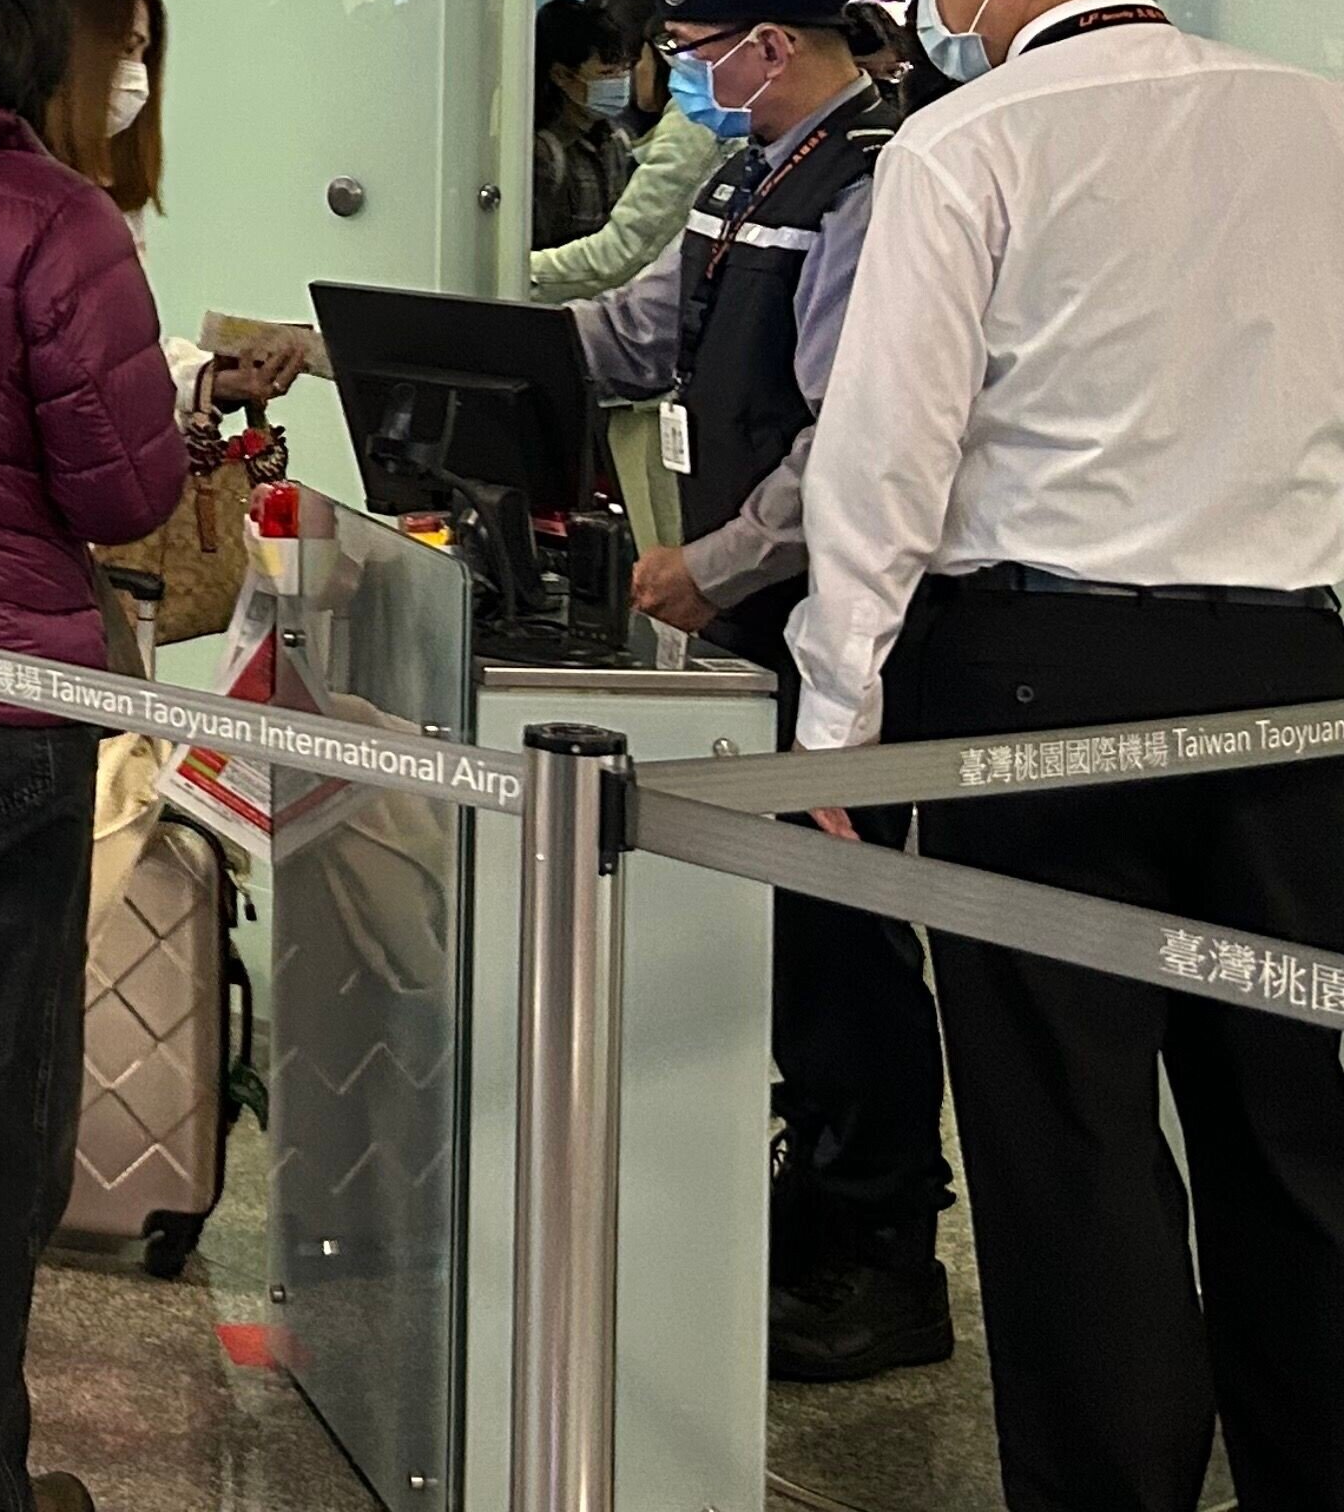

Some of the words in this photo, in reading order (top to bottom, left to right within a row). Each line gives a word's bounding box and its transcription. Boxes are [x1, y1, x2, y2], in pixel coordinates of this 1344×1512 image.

[45, 669, 134, 716] Taiwan
[141, 691, 253, 744] Taoyuan
[260, 711, 445, 785] International
[959, 730, 1170, 788] 臺灣桃園國際機場
[1172, 726, 1251, 760] Taiwan
[1255, 717, 1344, 754] Taoyuan
[1159, 926, 1344, 1014] 臺灣桃園
